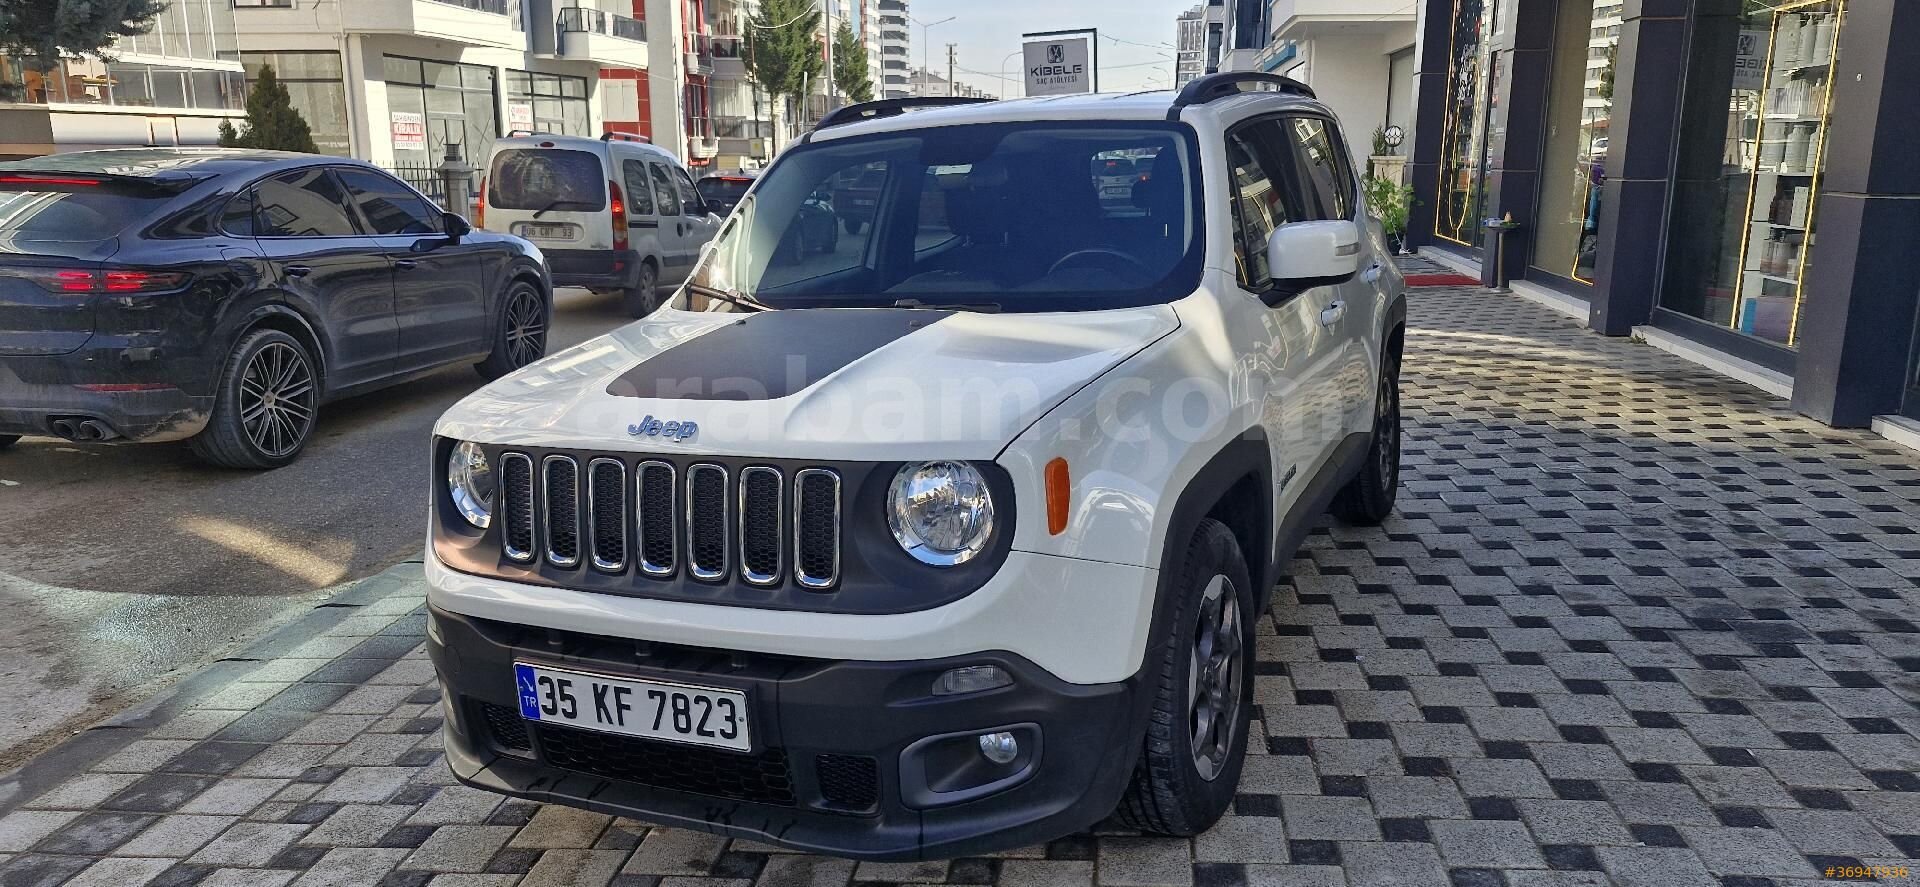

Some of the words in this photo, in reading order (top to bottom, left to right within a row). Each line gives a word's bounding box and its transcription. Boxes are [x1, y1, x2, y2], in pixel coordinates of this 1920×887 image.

[1030, 64, 1082, 77] KİBELE
[1036, 77, 1048, 86] SAÇ
[627, 414, 698, 443] Jeep
[523, 695, 537, 708] TR
[538, 675, 577, 719] 35
[592, 682, 632, 726] KF
[647, 689, 738, 740] 7823
